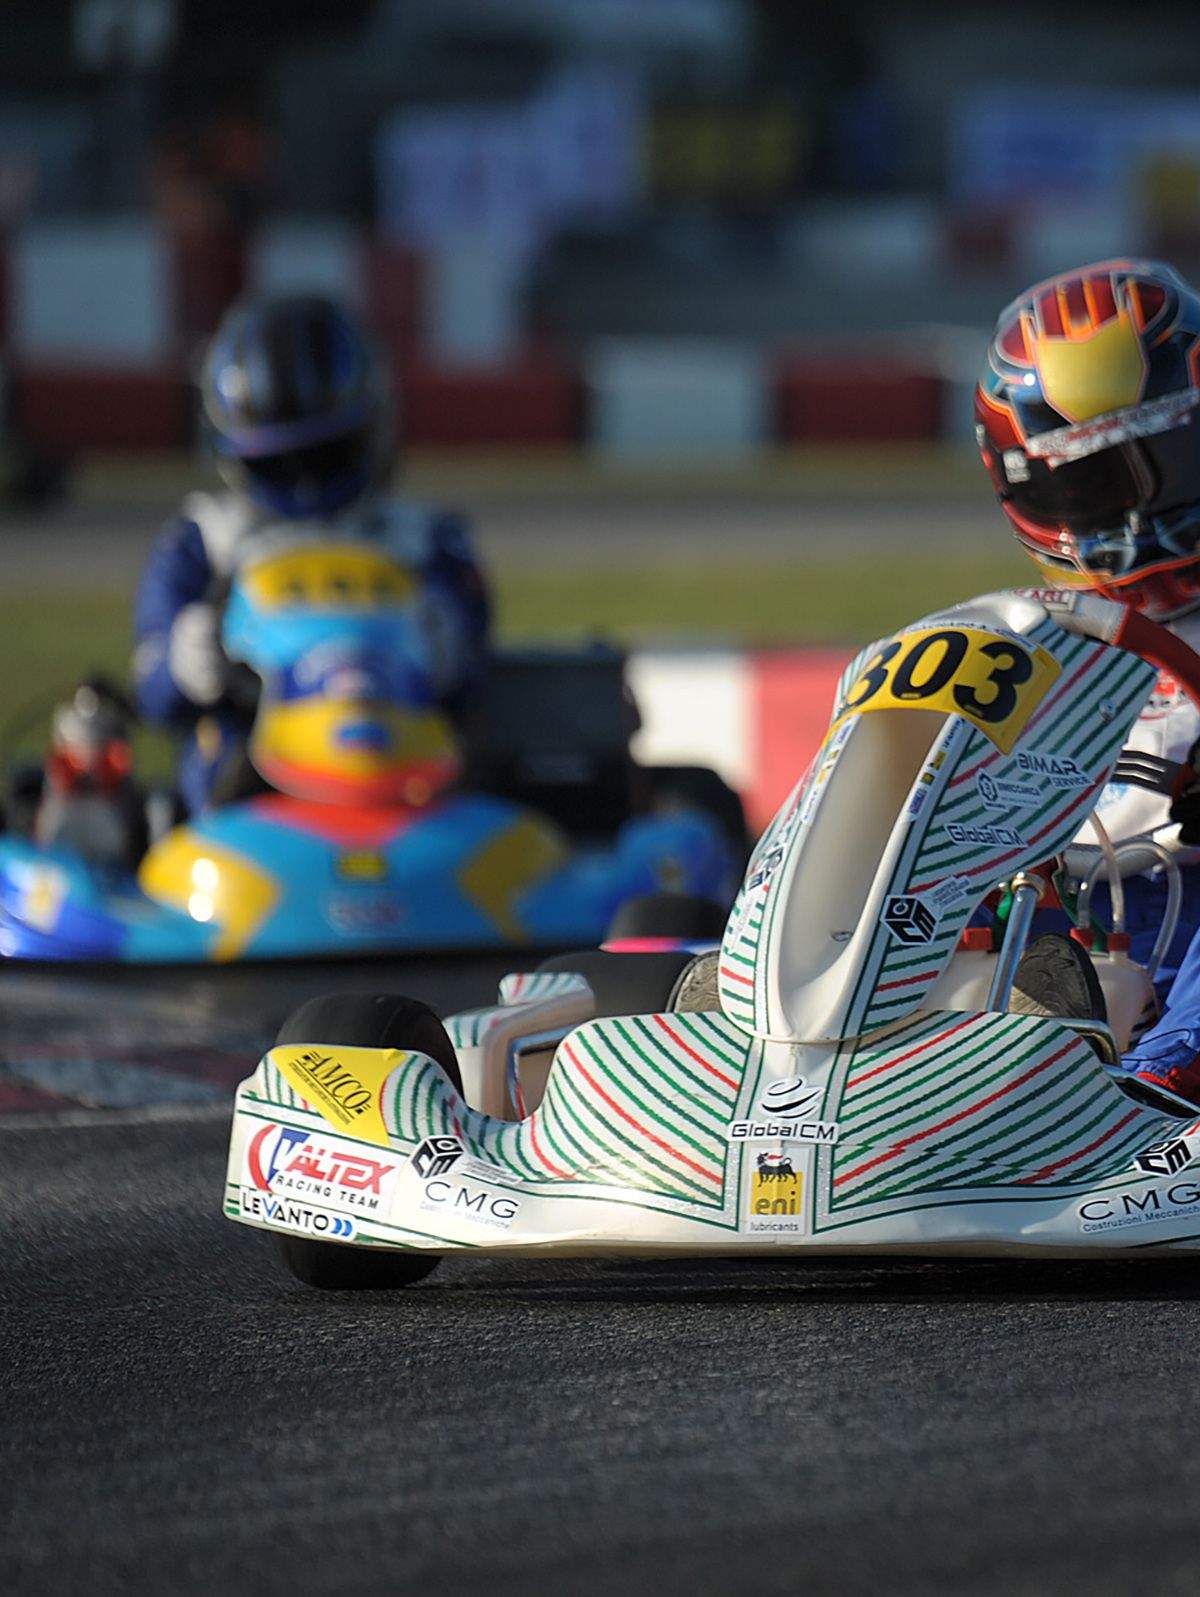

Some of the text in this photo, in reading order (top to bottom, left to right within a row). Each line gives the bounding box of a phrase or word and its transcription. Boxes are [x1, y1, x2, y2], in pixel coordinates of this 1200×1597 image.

[844, 630, 1033, 724] 303
[1017, 752, 1081, 776] BIMAR
[1051, 776, 1091, 788] SERVICE
[948, 825, 1026, 846] GlobalCM
[303, 1056, 372, 1110] AMCO
[731, 1122, 835, 1141] GlobalCM
[268, 1127, 396, 1196] VALTEX
[276, 1174, 380, 1210] RACING TEAM
[425, 1181, 519, 1219] CMG
[754, 1190, 796, 1216] eni
[242, 1190, 330, 1232] LEVANTO
[1082, 1215, 1142, 1232] Costruzioni
[751, 1222, 799, 1232] lubricants
